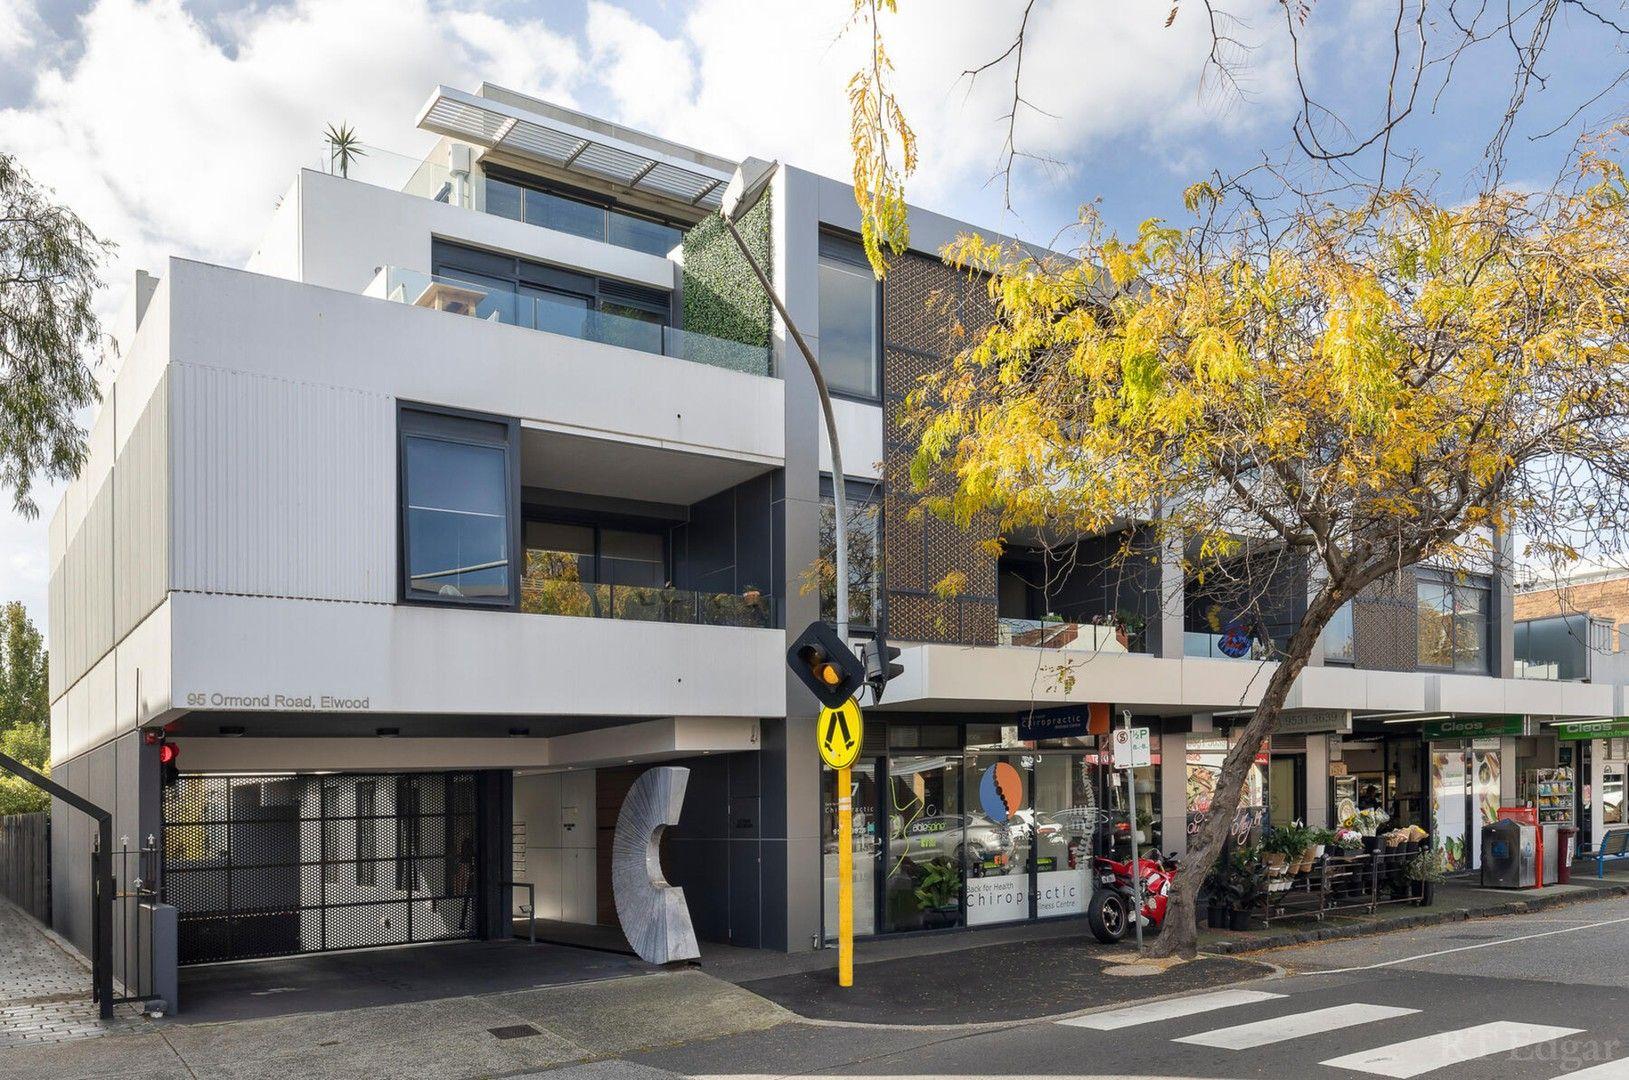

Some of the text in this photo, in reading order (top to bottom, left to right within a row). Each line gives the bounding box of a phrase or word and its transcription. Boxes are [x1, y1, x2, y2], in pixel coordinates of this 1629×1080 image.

[186, 693, 206, 706] 95
[210, 692, 270, 707] Ormond
[274, 694, 316, 709] Road,
